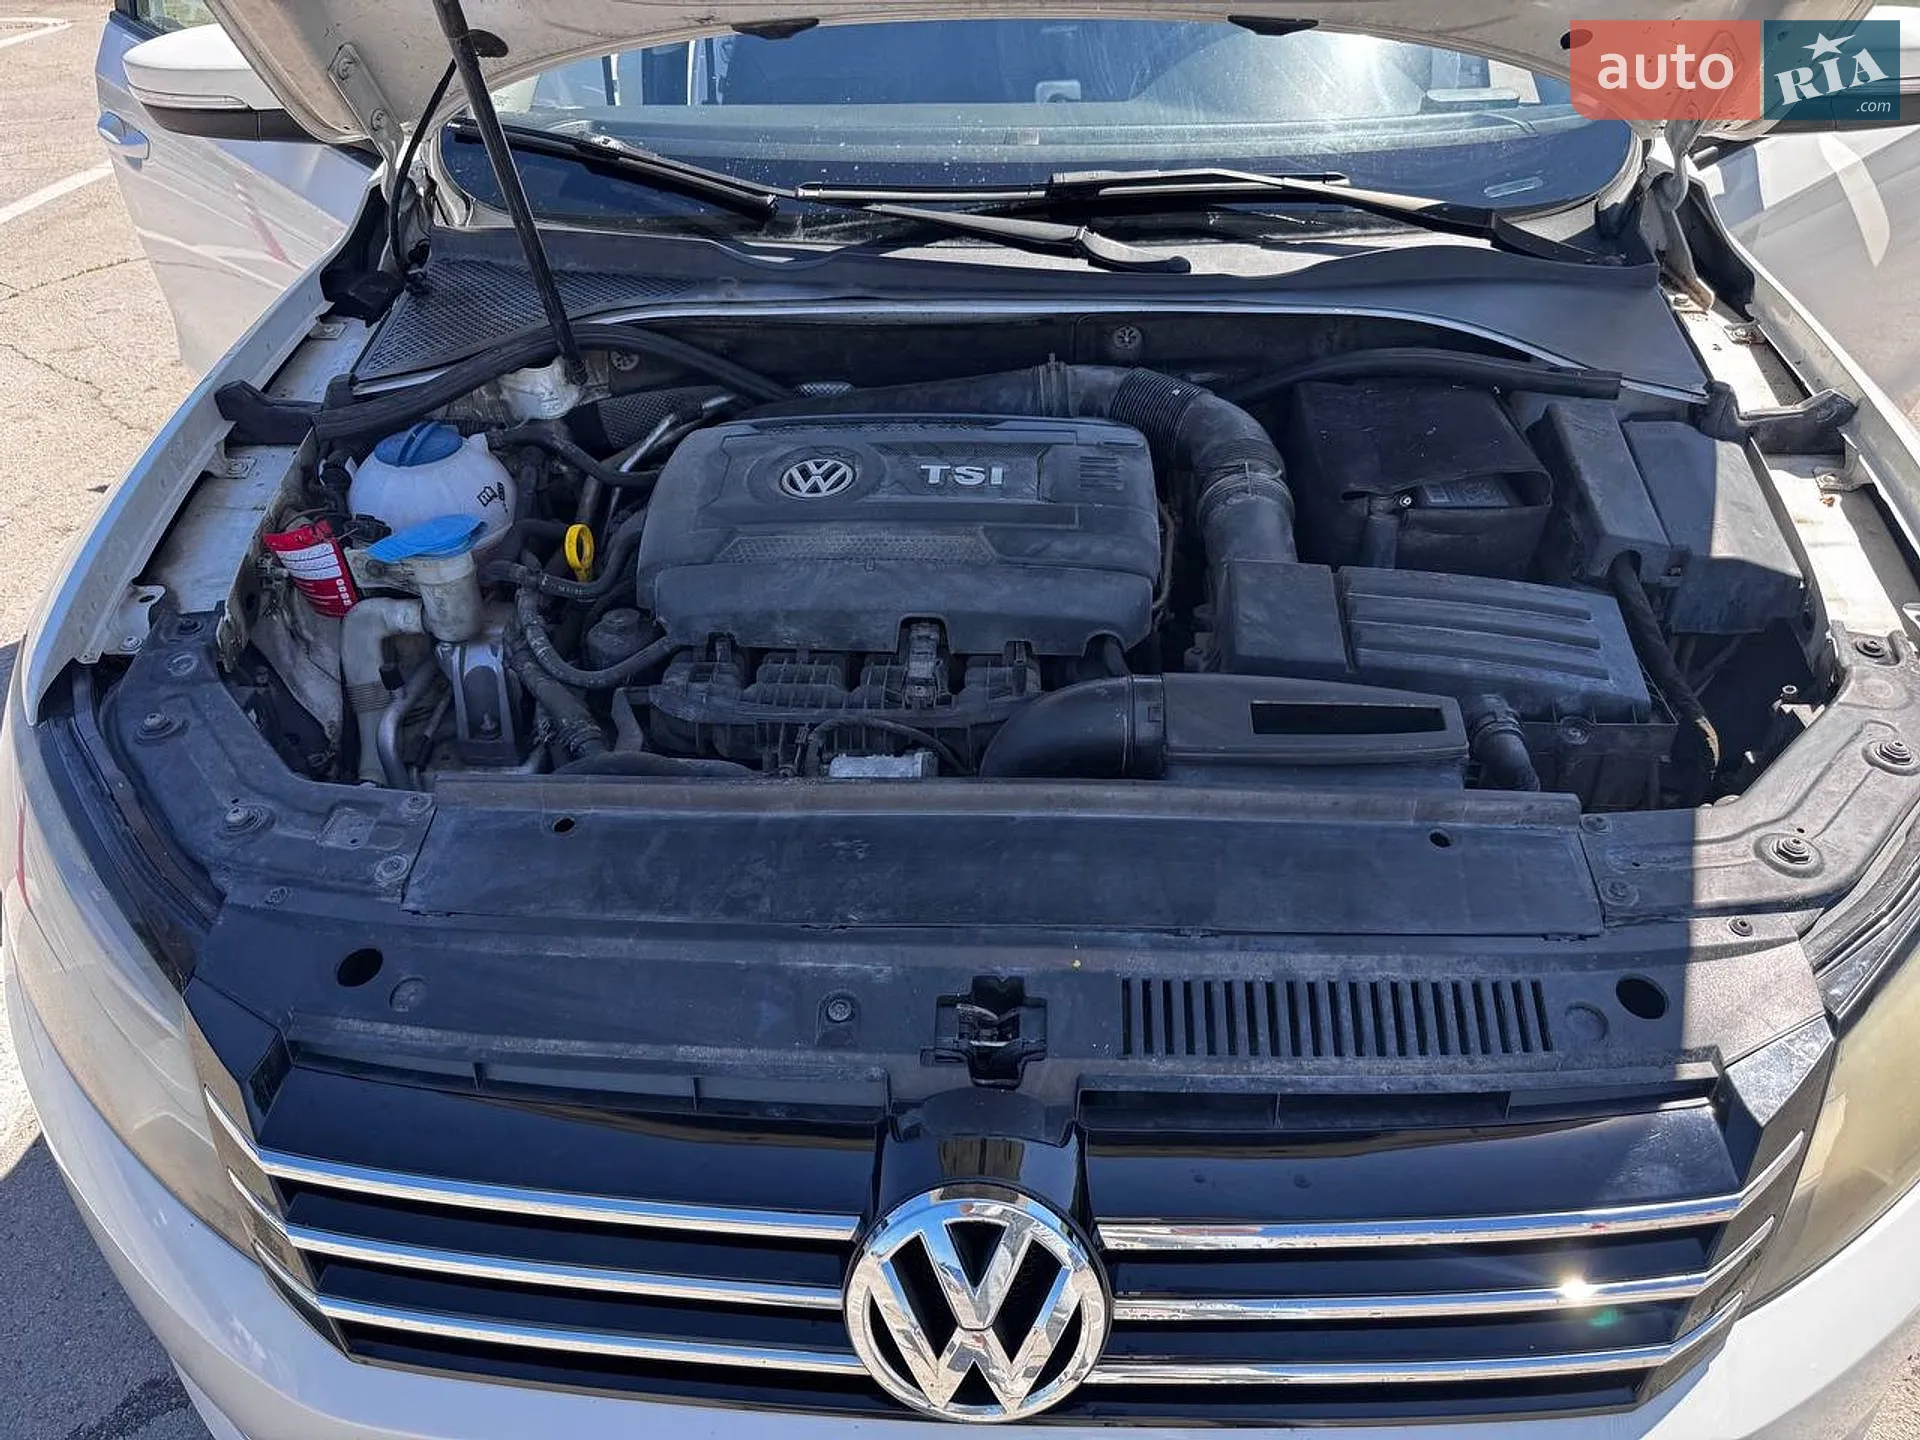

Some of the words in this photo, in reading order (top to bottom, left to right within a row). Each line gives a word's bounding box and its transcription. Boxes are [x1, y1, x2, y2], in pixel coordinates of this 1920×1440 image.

[780, 458, 854, 498] VW
[920, 464, 1003, 486] TSI
[847, 1186, 1105, 1422] VW
